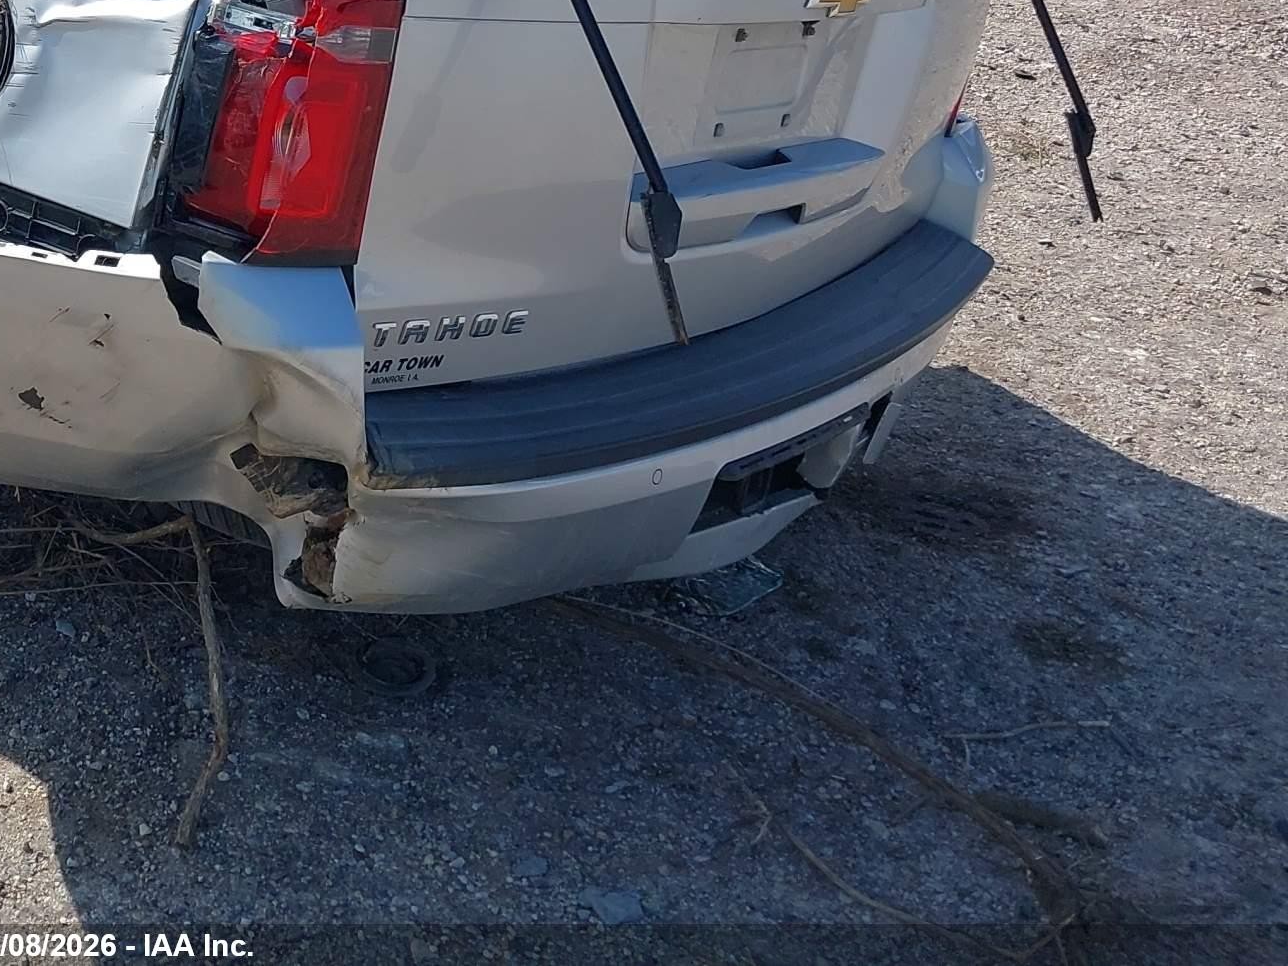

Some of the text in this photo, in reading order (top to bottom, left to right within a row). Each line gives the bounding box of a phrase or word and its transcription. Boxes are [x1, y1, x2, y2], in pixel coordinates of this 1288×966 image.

[373, 309, 529, 348] TAHOE
[397, 354, 444, 371] TOWN
[372, 374, 407, 385] MONROE
